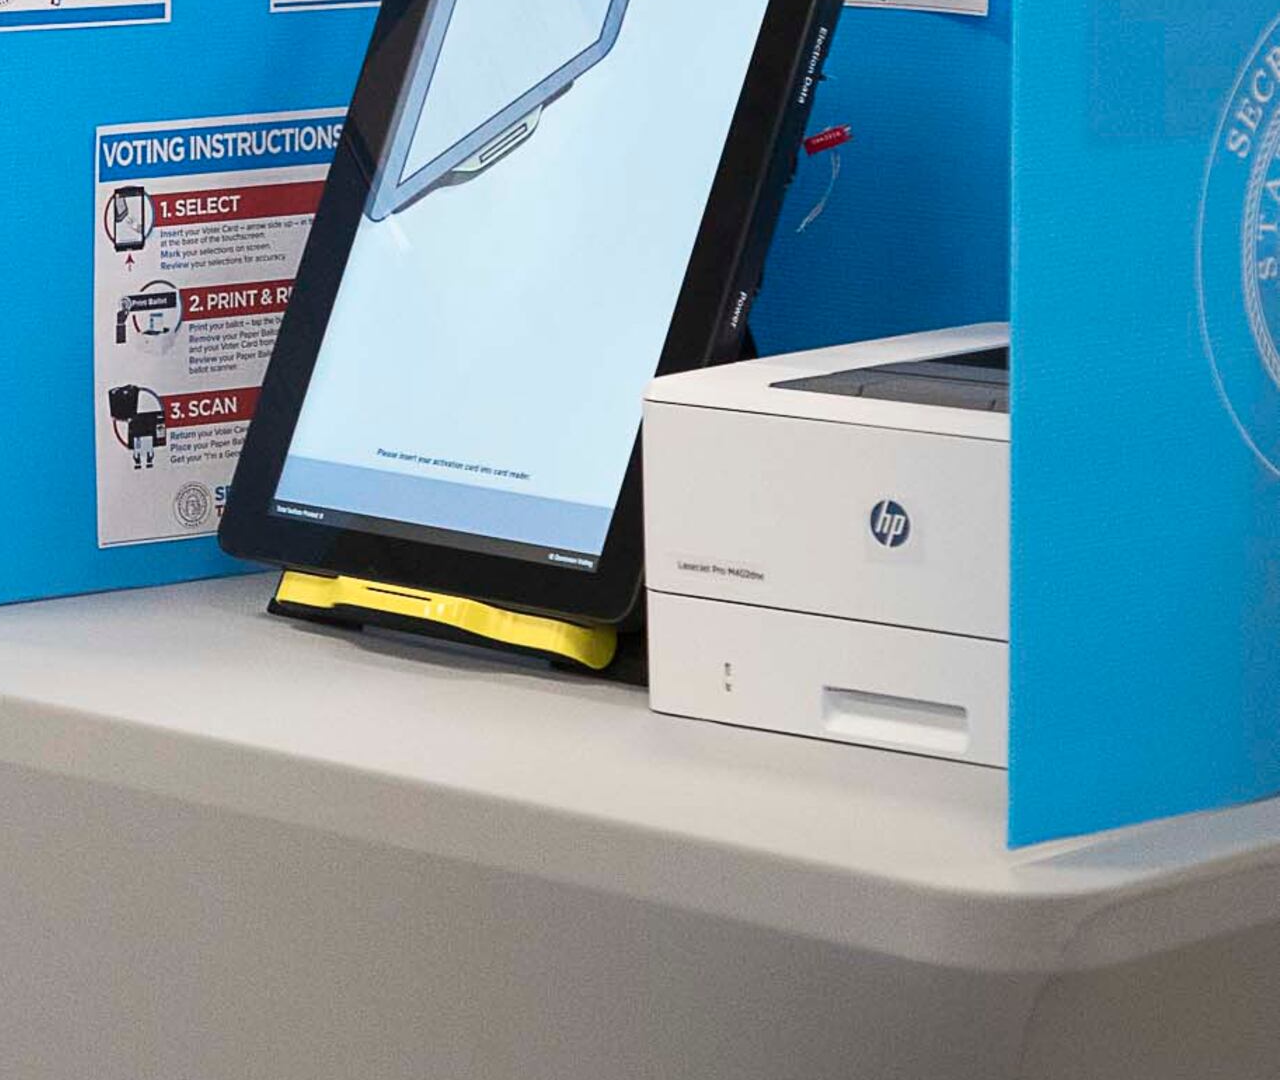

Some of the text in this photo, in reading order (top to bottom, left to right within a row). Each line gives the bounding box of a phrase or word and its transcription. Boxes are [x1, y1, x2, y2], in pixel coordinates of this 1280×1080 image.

[798, 26, 828, 104] Election Data
[102, 124, 343, 168] VOTING INSTRUCTIONS
[160, 195, 241, 219] 1. SELECT
[189, 289, 273, 312] 2. PRINT &
[170, 397, 237, 419] 3. SCAN
[872, 499, 908, 548] hp
